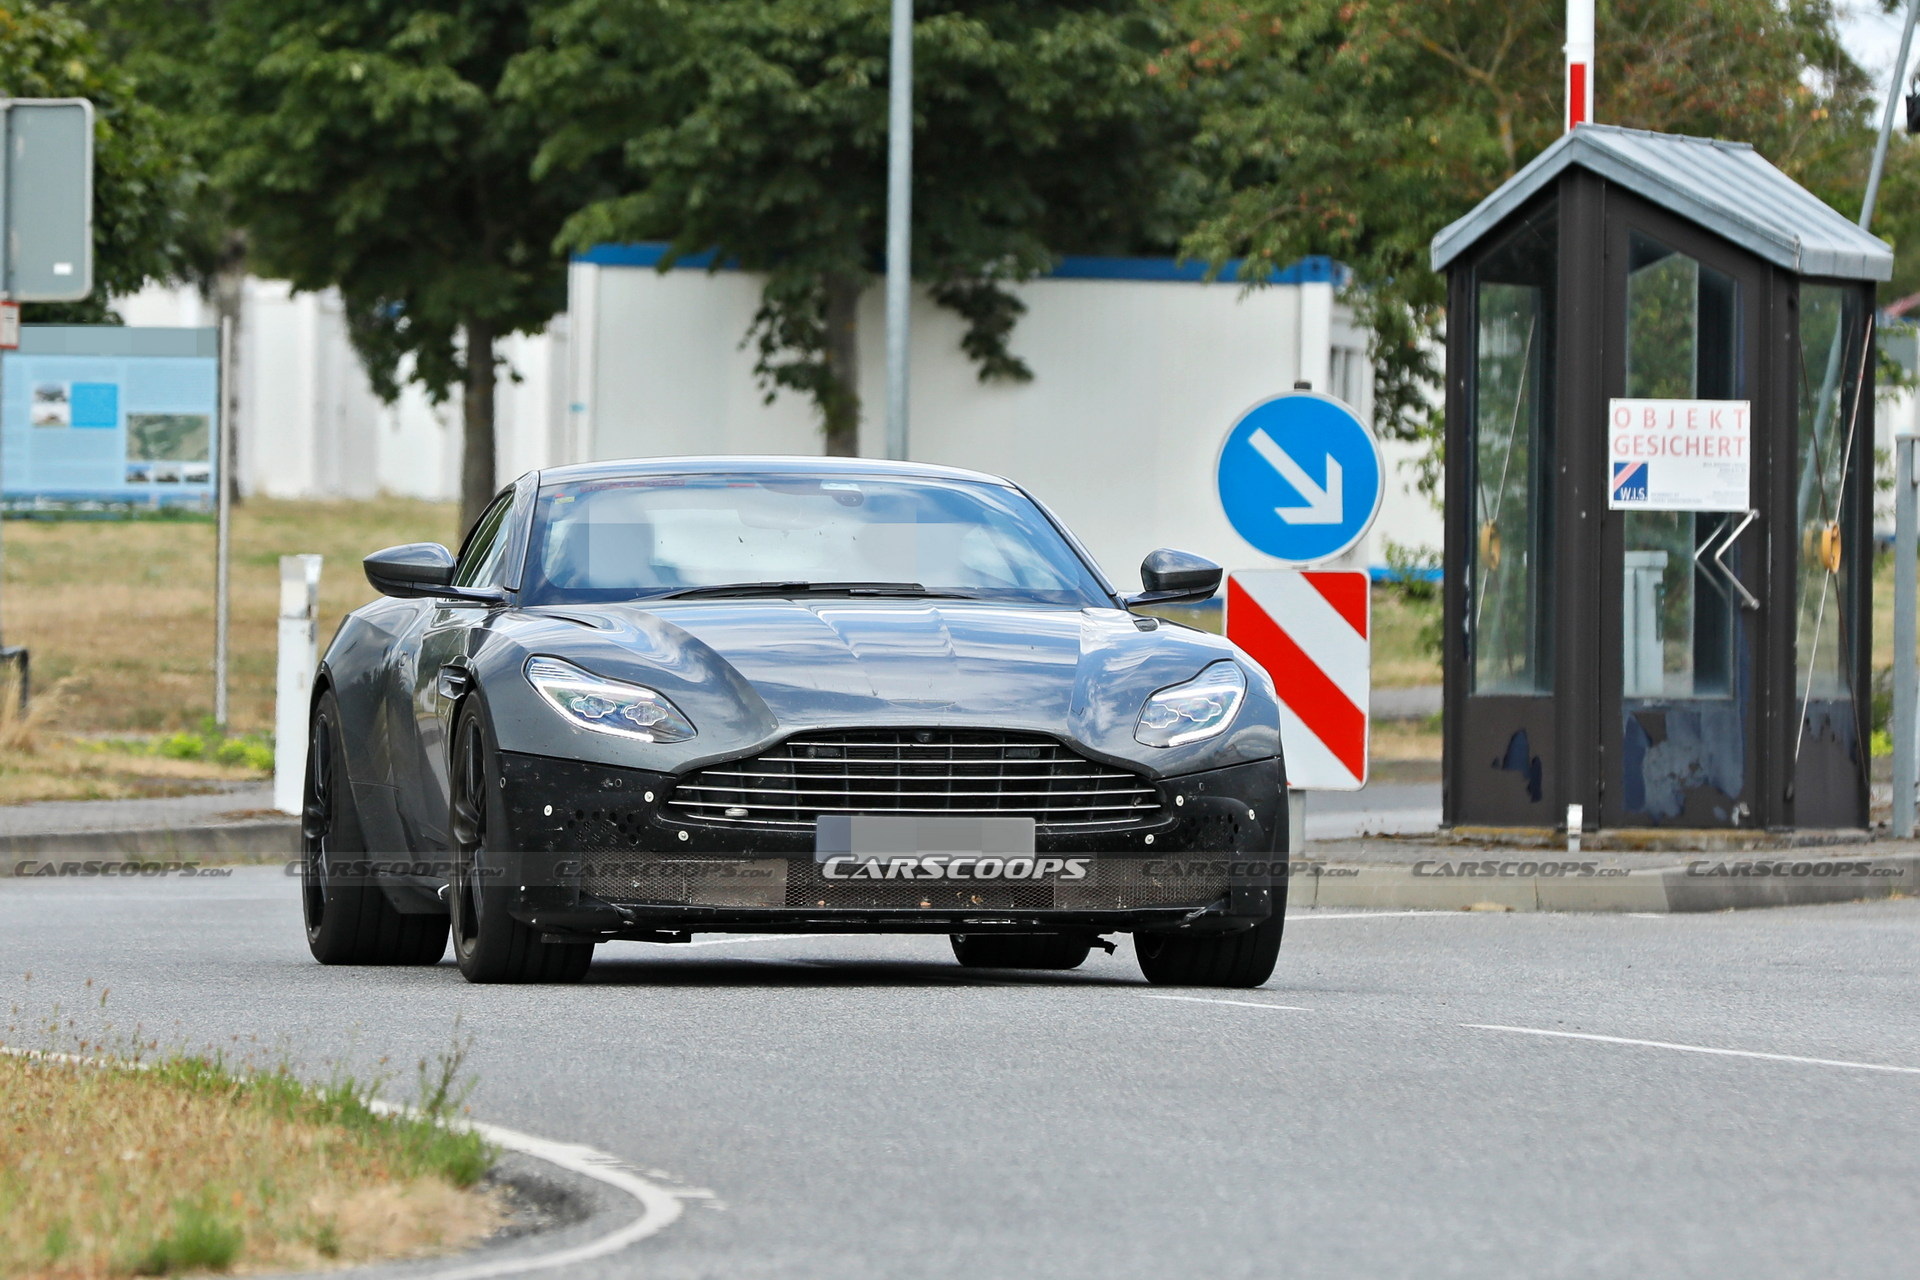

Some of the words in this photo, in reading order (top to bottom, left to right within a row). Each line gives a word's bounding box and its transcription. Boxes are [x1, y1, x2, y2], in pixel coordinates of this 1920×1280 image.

[1614, 407, 1747, 430] OBJEKT
[1614, 435, 1746, 457] GESICHERT
[1620, 487, 1648, 501] W.I.S.
